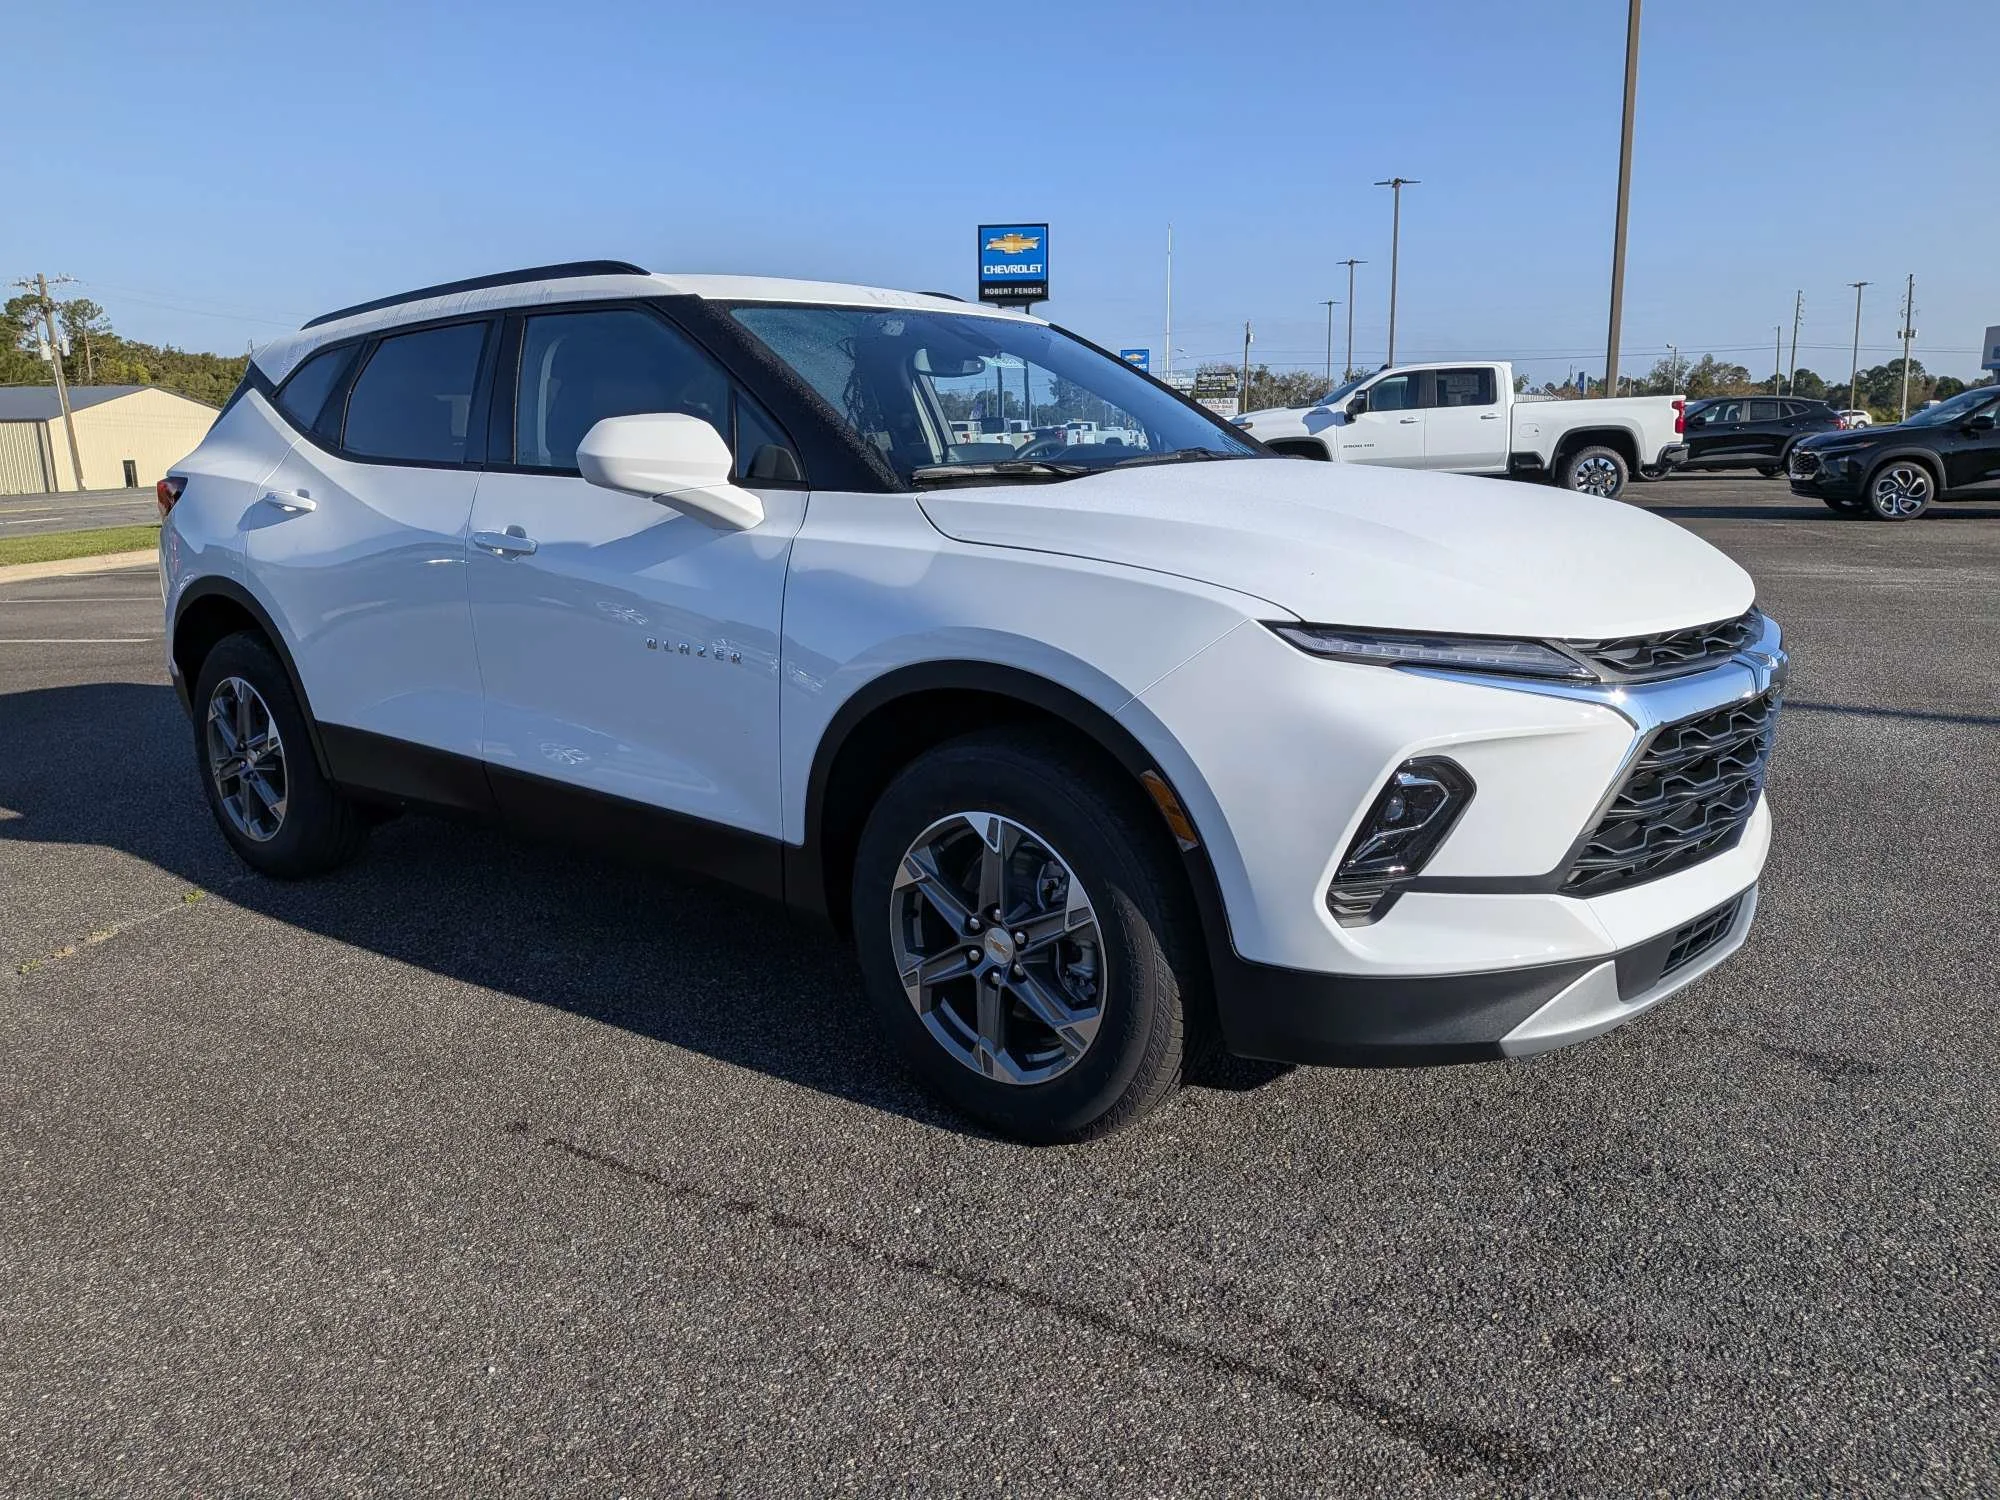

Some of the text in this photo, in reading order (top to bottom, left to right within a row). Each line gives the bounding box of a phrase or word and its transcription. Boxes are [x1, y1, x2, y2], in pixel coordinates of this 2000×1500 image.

[983, 263, 1043, 274] CHEVROLET
[984, 287, 1042, 295] ROBERT FENDER
[646, 638, 743, 664] BLAZER
